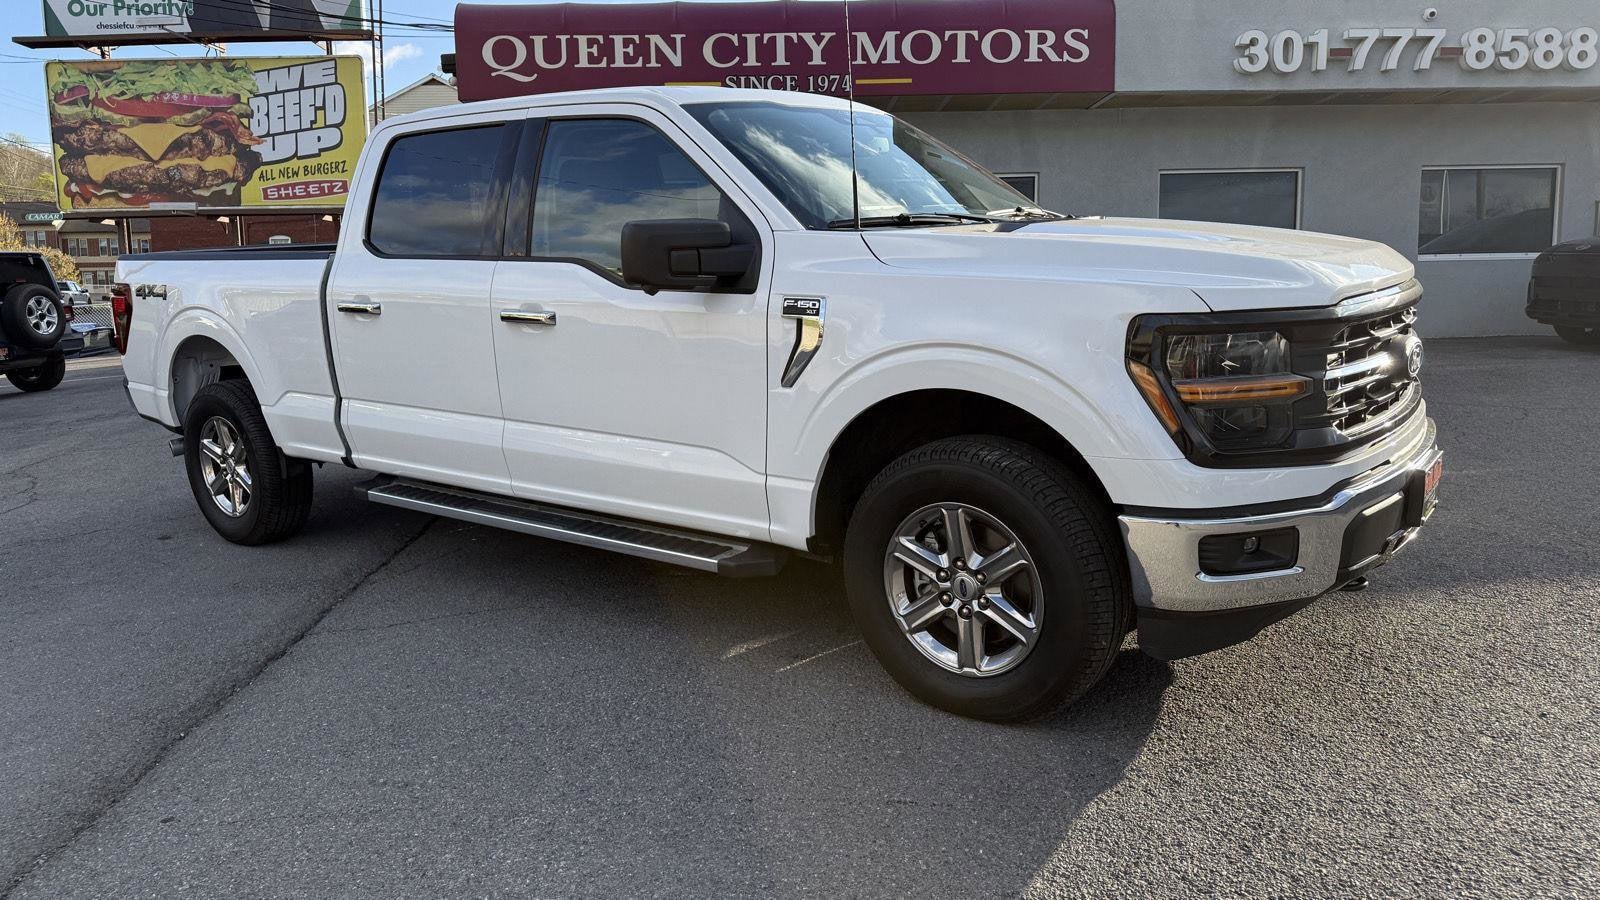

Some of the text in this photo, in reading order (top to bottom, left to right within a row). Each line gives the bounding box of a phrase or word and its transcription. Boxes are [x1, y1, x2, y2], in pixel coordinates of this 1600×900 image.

[67, 0, 194, 18] Our Priority!
[481, 28, 1090, 82] QUEEN CITY MOTORS
[254, 60, 335, 95] WE
[725, 74, 851, 92] SINCE 1974
[249, 84, 344, 136] BEEF'D
[252, 127, 341, 163] UP
[259, 160, 348, 182] ALL NEW BURGERZ
[267, 181, 344, 199] SHEETZ
[784, 299, 819, 309] F-150
